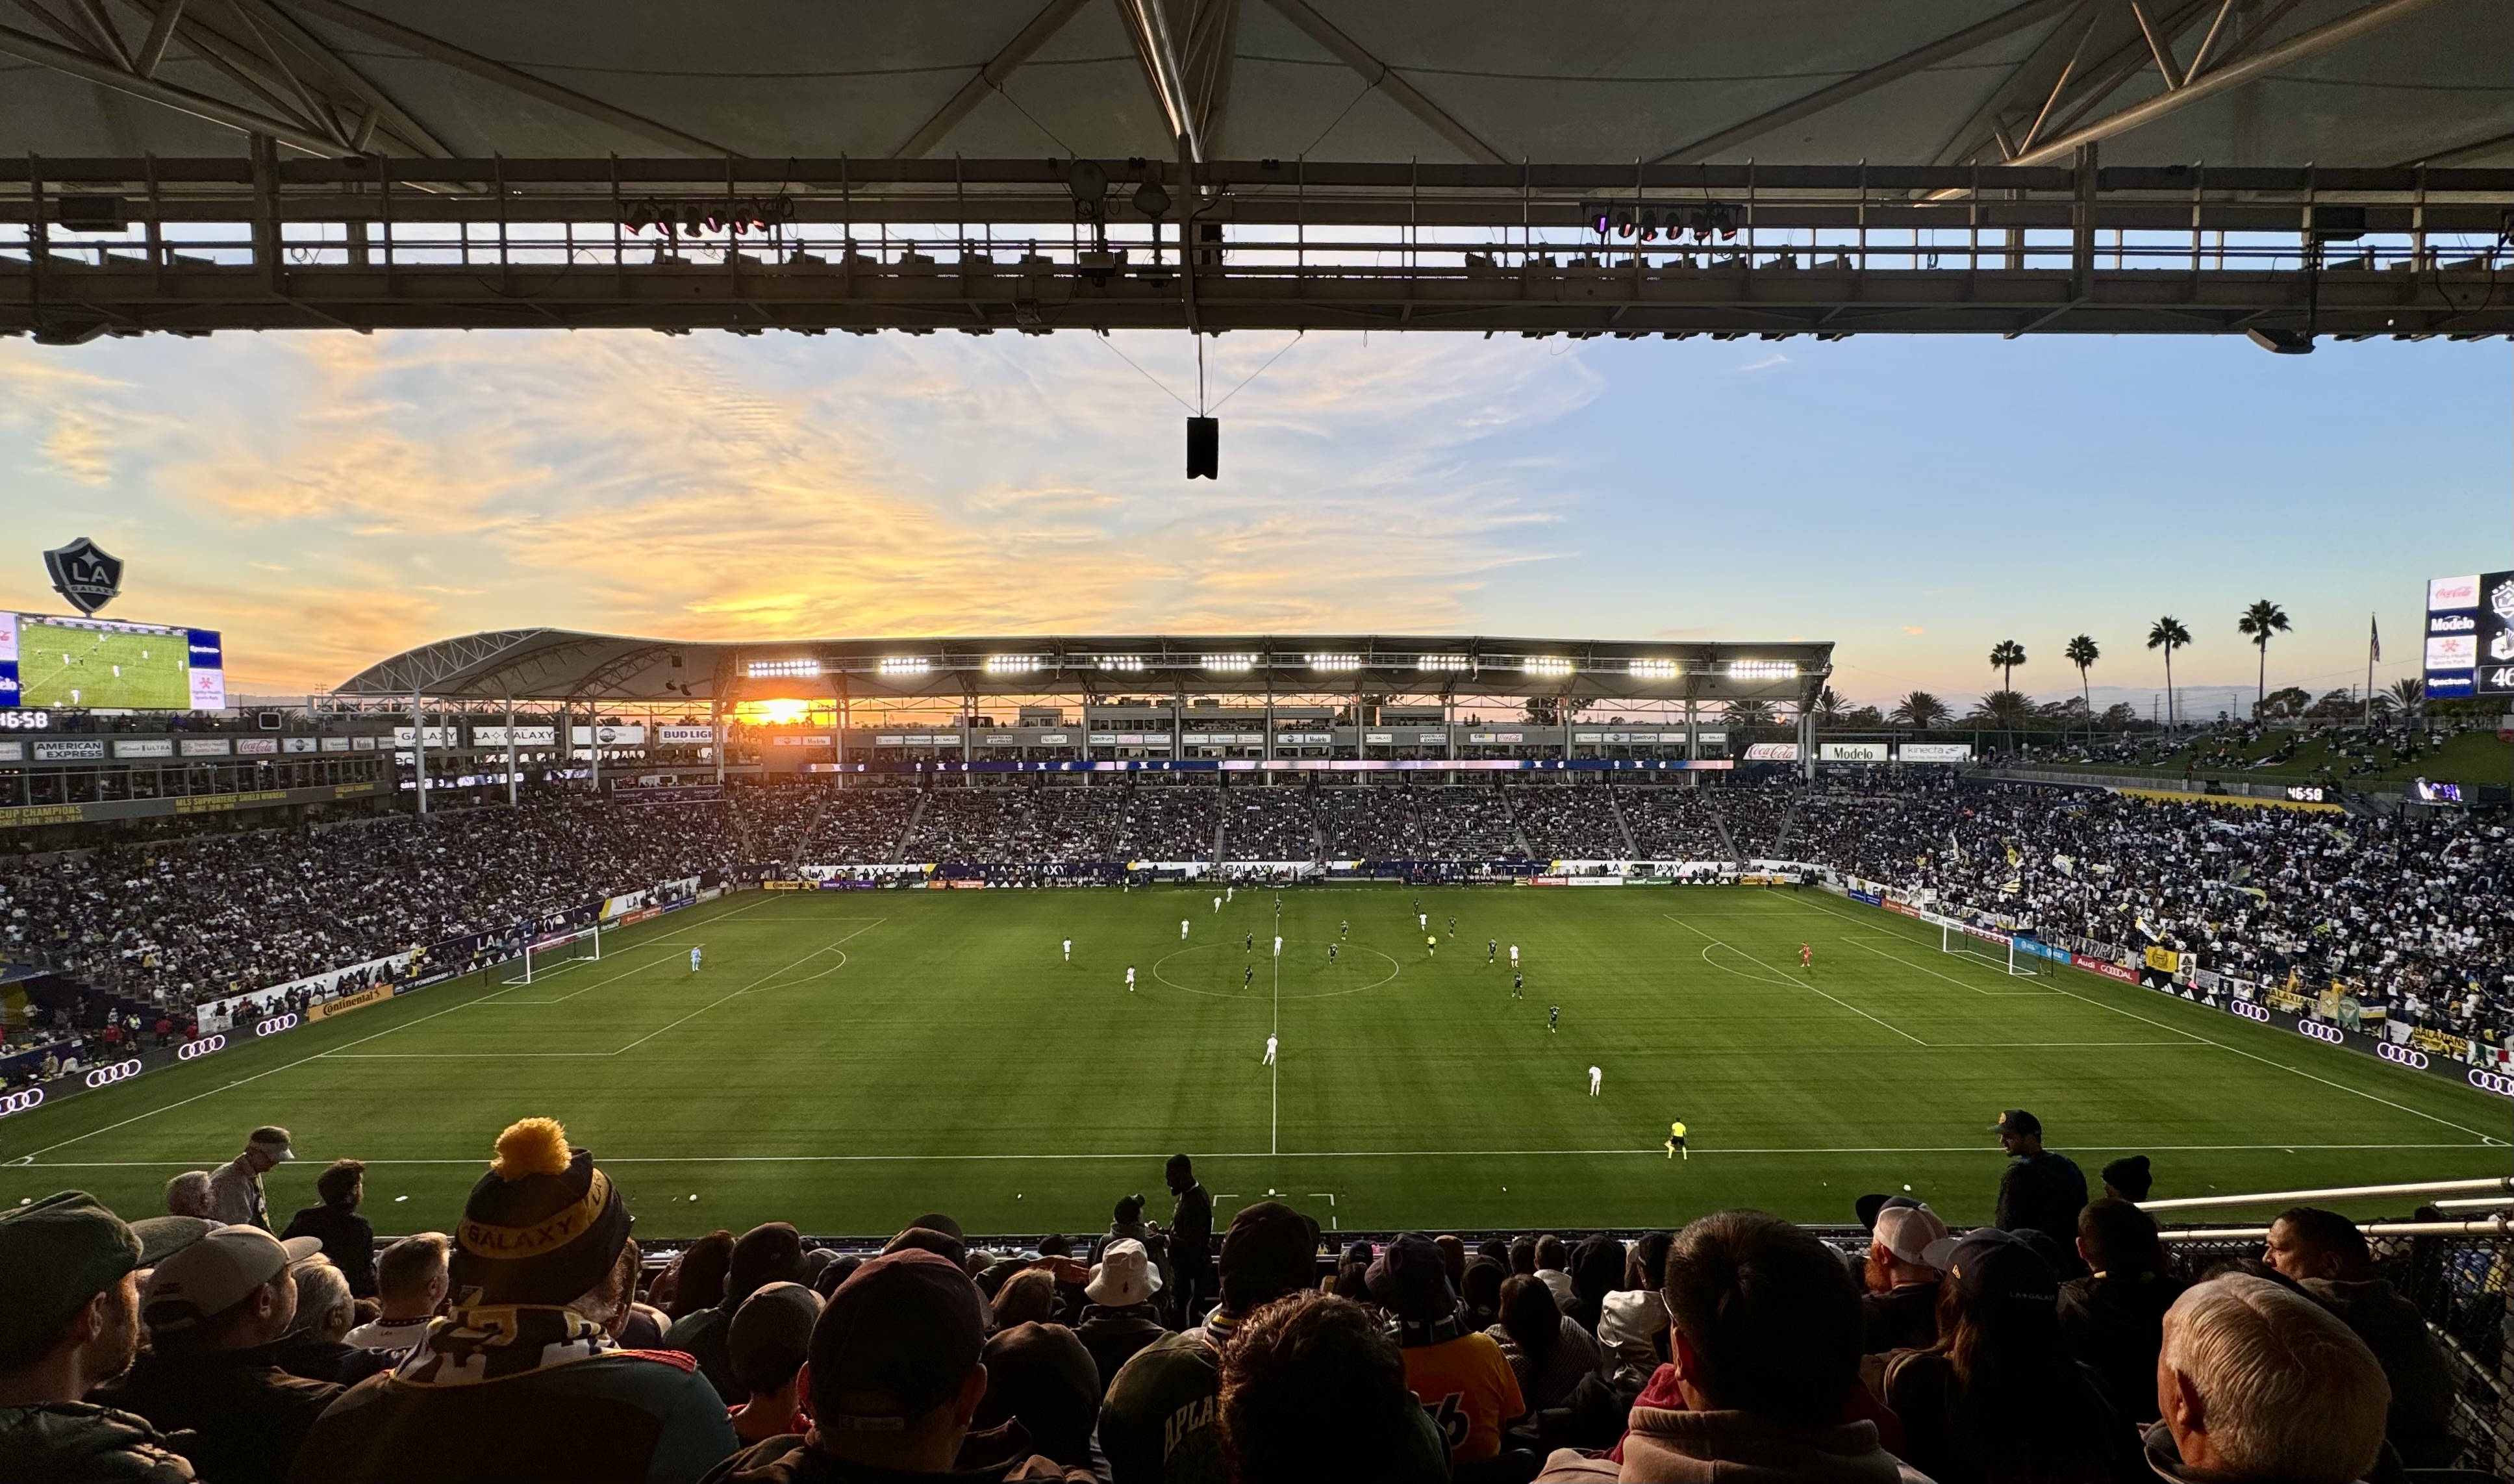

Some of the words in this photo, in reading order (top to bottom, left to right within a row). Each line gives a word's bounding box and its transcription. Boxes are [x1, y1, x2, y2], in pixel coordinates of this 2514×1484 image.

[72, 562, 111, 584] LA
[71, 586, 117, 596] GALAXY
[2431, 617, 2475, 631] Modelo
[0, 678, 18, 690] elo
[1833, 747, 1873, 759] Modelo
[1907, 745, 1944, 754] kinecta
[239, 793, 260, 801] SHIELD
[2287, 787, 2323, 801] 46:58
[23, 805, 82, 818] CHAMPIONS
[626, 896, 638, 909] LA
[477, 935, 496, 951] LA
[2077, 958, 2095, 969] Audi
[323, 990, 374, 1016] Continental
[2270, 989, 2319, 1008] ALAXIANS
[468, 1215, 572, 1250] GALAXY
